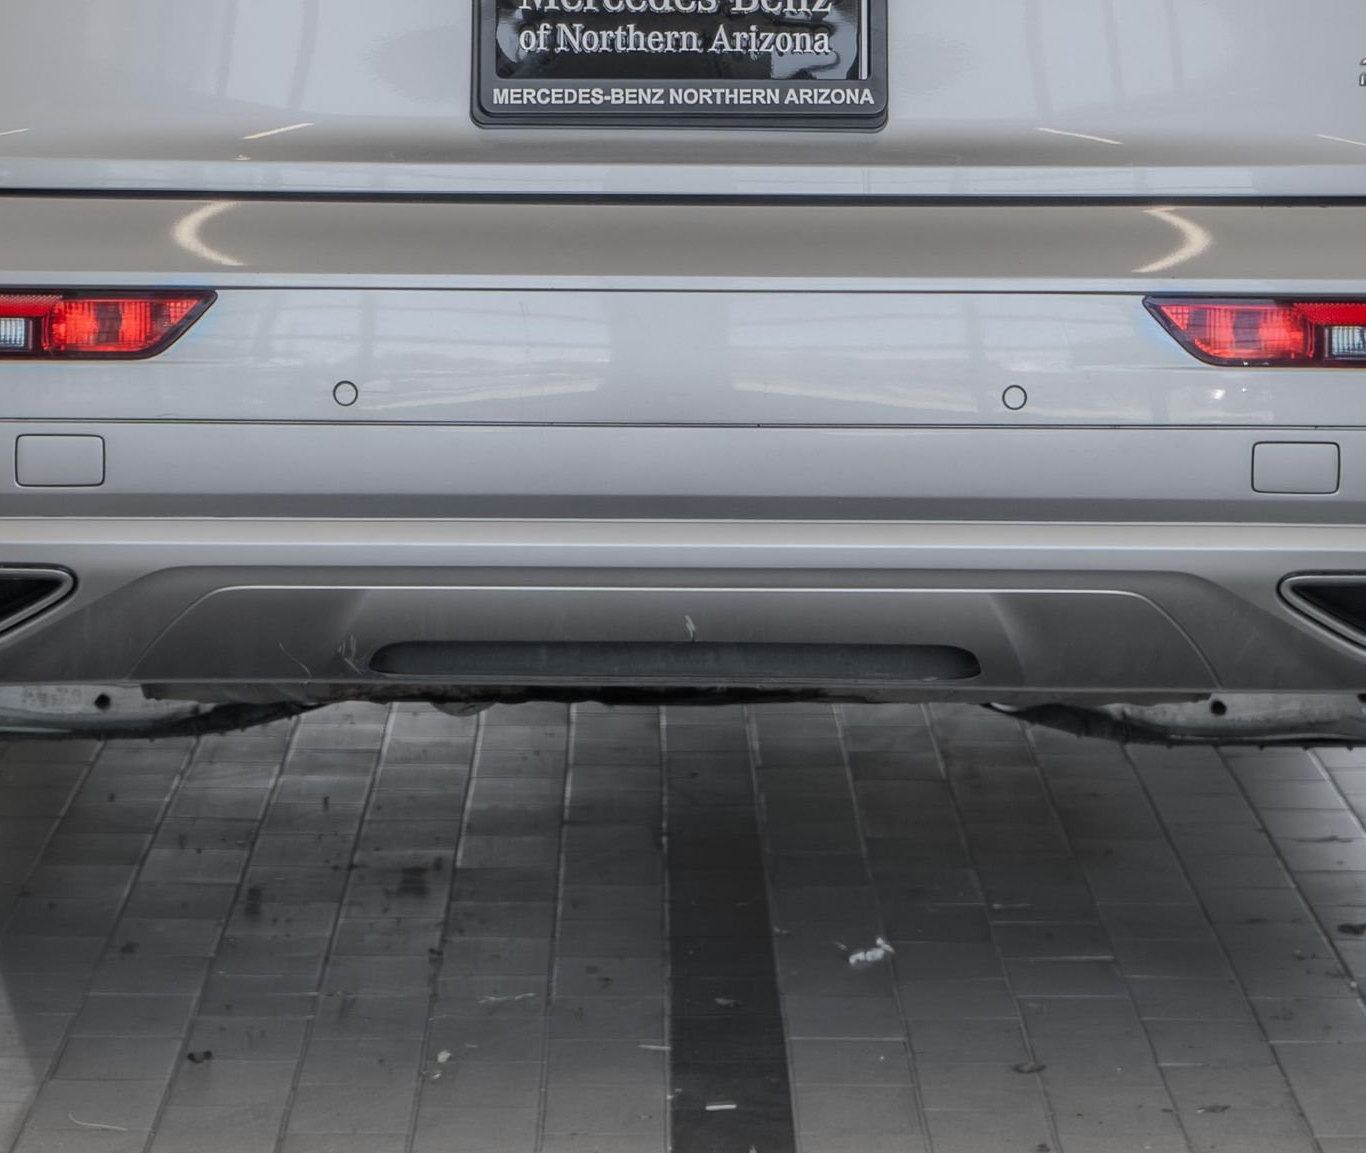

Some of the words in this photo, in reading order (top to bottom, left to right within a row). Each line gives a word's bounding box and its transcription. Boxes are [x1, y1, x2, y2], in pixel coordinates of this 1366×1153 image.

[519, 24, 552, 53] of
[555, 23, 700, 54] Northern
[711, 24, 831, 54] Arizona
[492, 88, 665, 106] MERCEDES-BENZ
[668, 88, 781, 106] NORTHERN
[784, 88, 875, 105] ARIZONA
